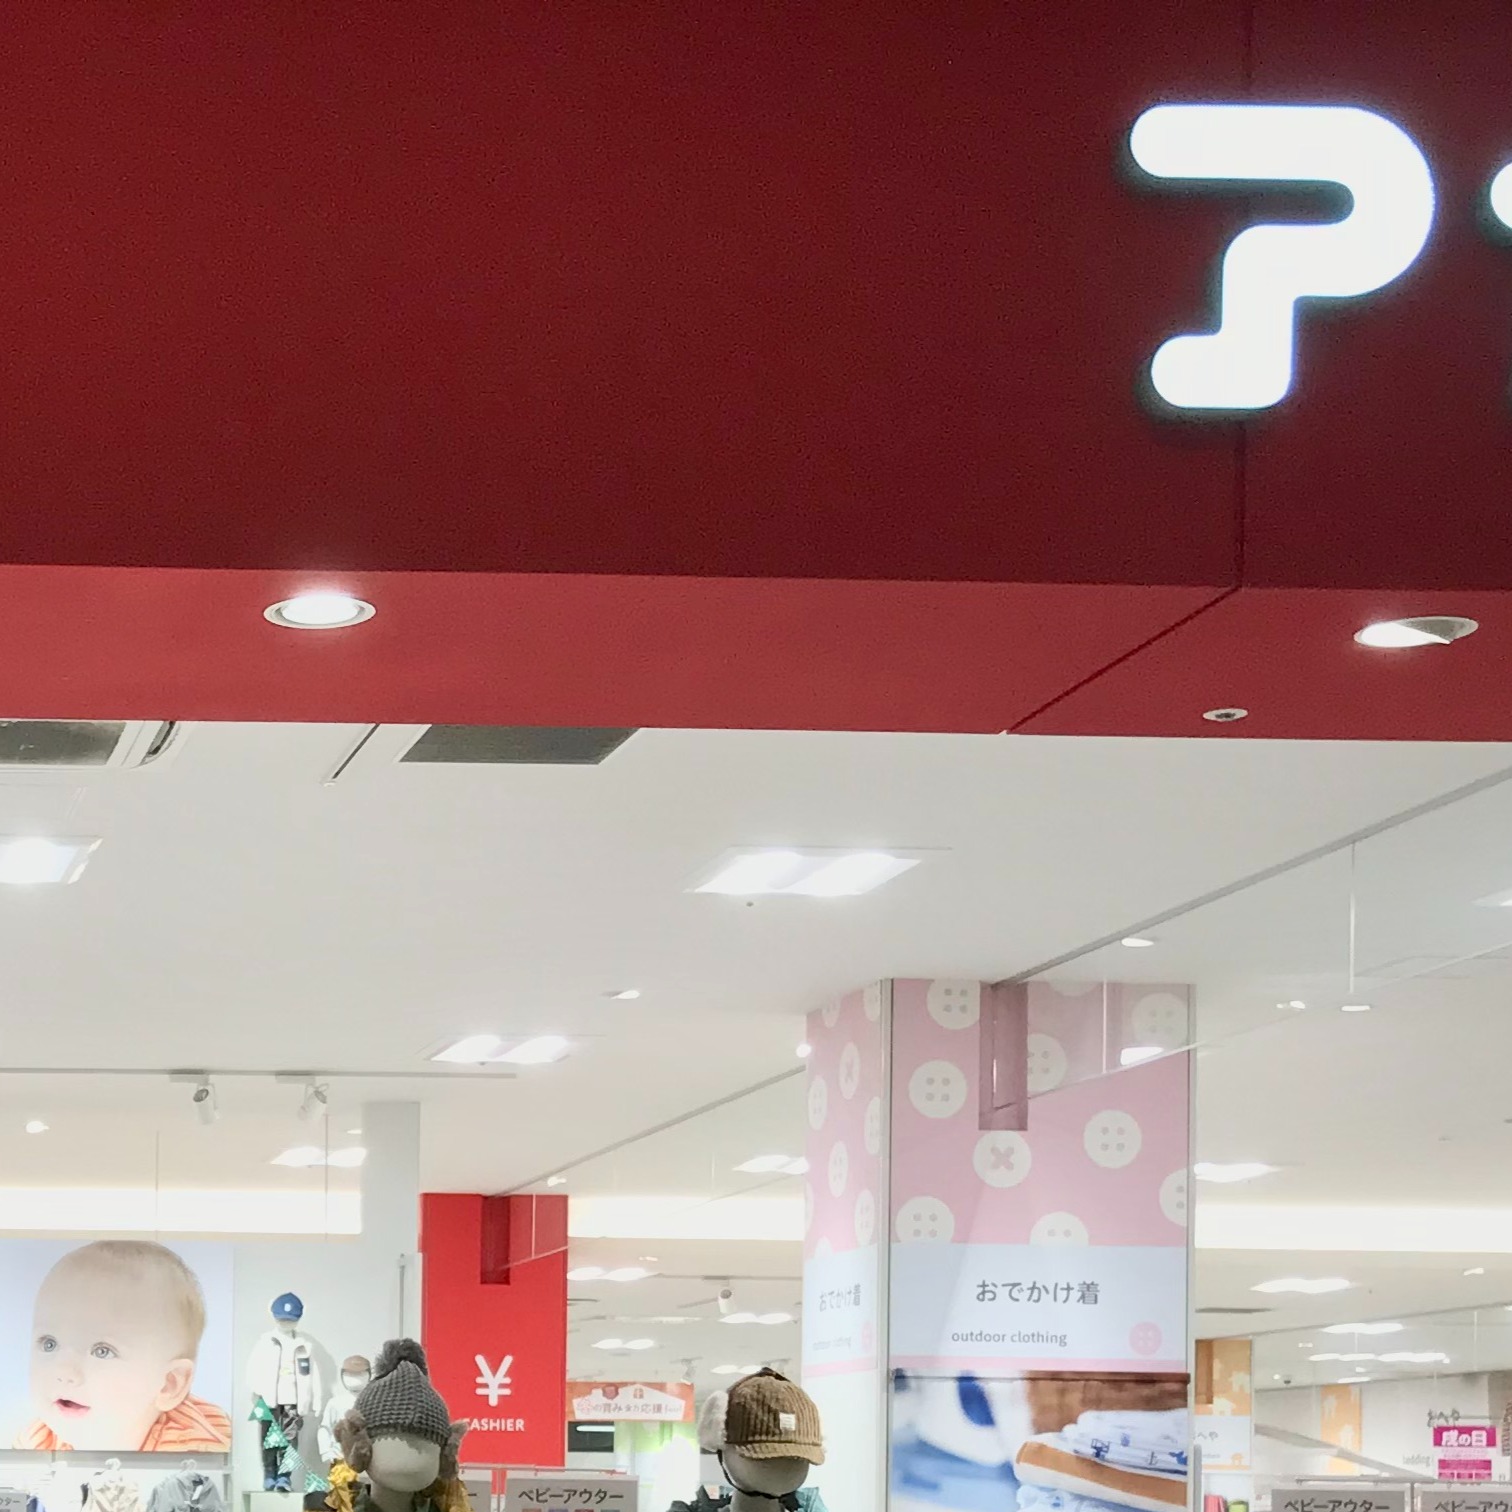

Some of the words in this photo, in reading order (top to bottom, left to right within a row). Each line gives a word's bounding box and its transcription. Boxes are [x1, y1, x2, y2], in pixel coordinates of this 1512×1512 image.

[1129, 103, 1512, 411] ア
[975, 1279, 1100, 1305] おでかけ着
[951, 1331, 1006, 1344] outdoor
[1010, 1331, 1068, 1347] clothing
[518, 1488, 624, 1504] ベビーアウター
